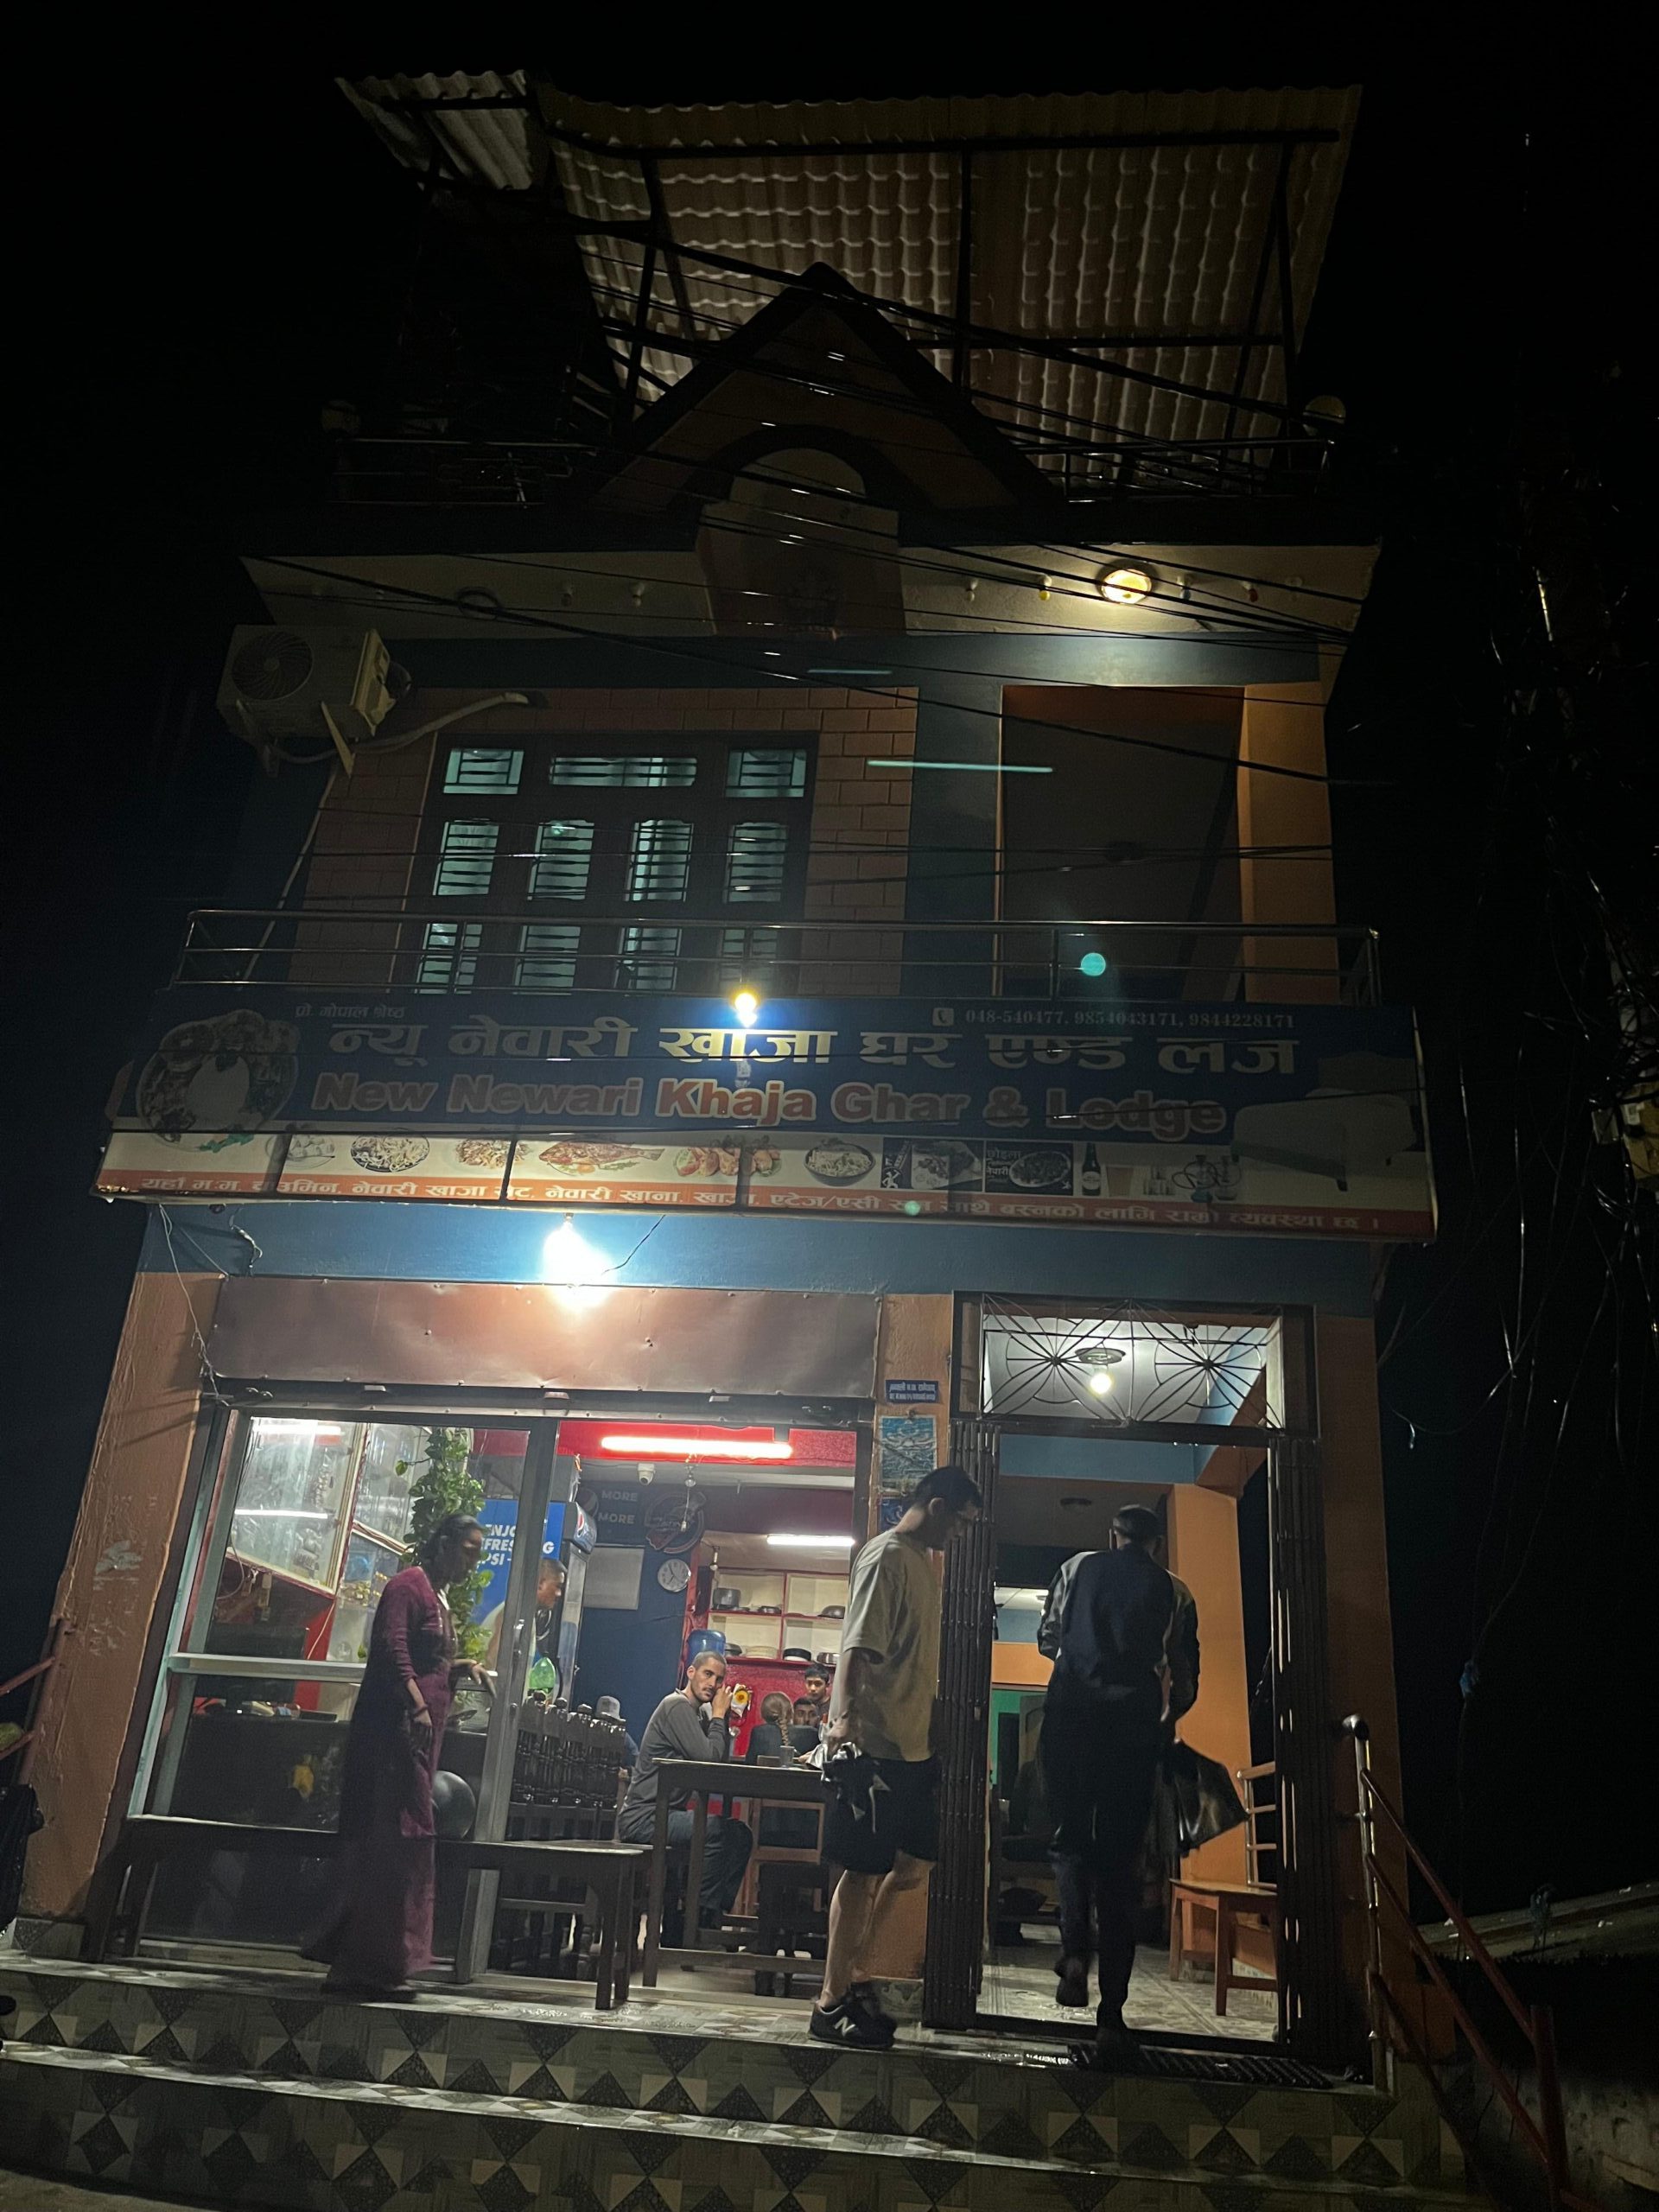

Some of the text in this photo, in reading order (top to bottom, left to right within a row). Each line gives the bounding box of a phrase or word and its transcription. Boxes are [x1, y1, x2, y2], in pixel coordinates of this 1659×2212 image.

[319, 1002, 369, 1019] गोपाल
[1188, 1013, 1294, 1028] 9844228171
[329, 1014, 1299, 1074] न्यू नेवारी खाजा घर एण्ड लज
[310, 1072, 1227, 1142] New Newari Khaja Ghar & Lodge
[352, 1180, 418, 1196] नेवारी
[425, 1185, 486, 1198] खाजा
[545, 1185, 613, 1200] नेवारी
[1095, 1205, 1155, 1220] लागि
[601, 1489, 639, 1503] MORE
[598, 1512, 636, 1524] MORE
